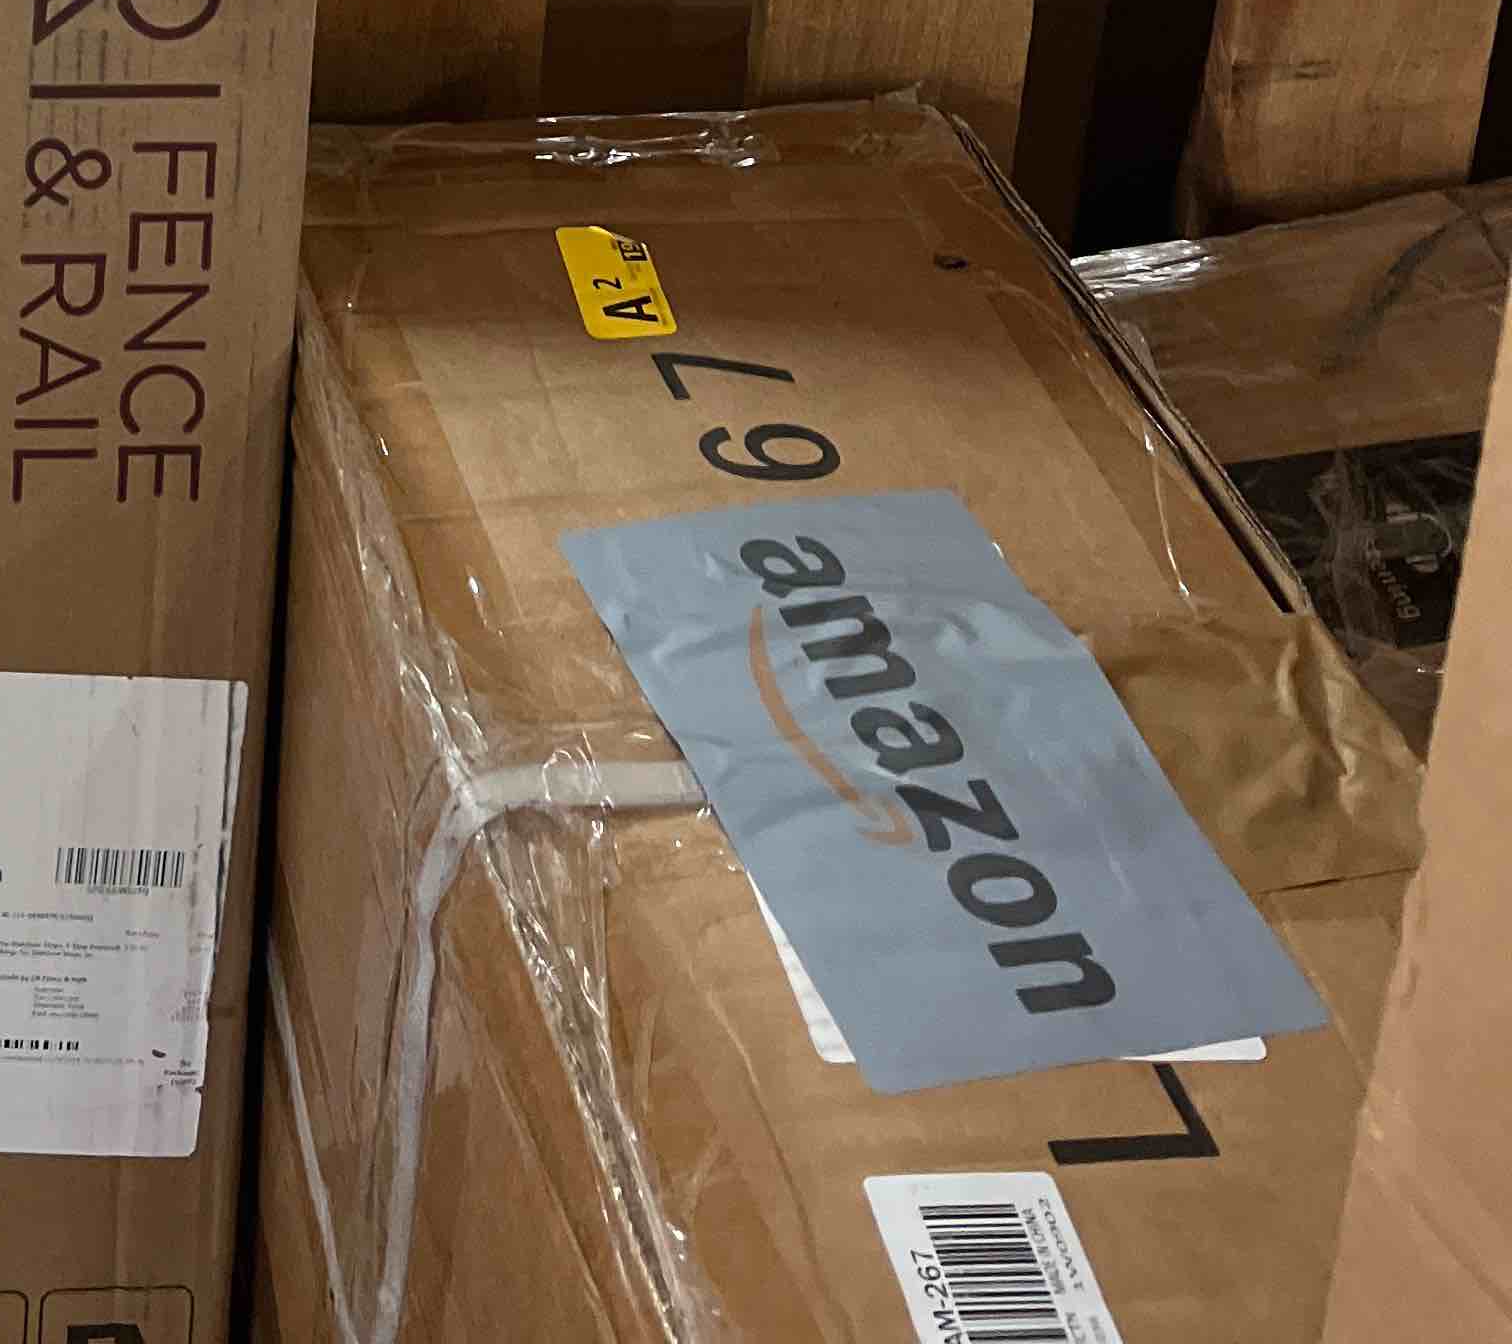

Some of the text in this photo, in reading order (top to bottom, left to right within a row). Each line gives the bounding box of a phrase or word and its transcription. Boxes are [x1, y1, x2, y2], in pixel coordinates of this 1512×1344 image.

[13, 137, 113, 504] & RAIL
[117, 140, 218, 504] FENCE
[738, 534, 1118, 1017] amazon
